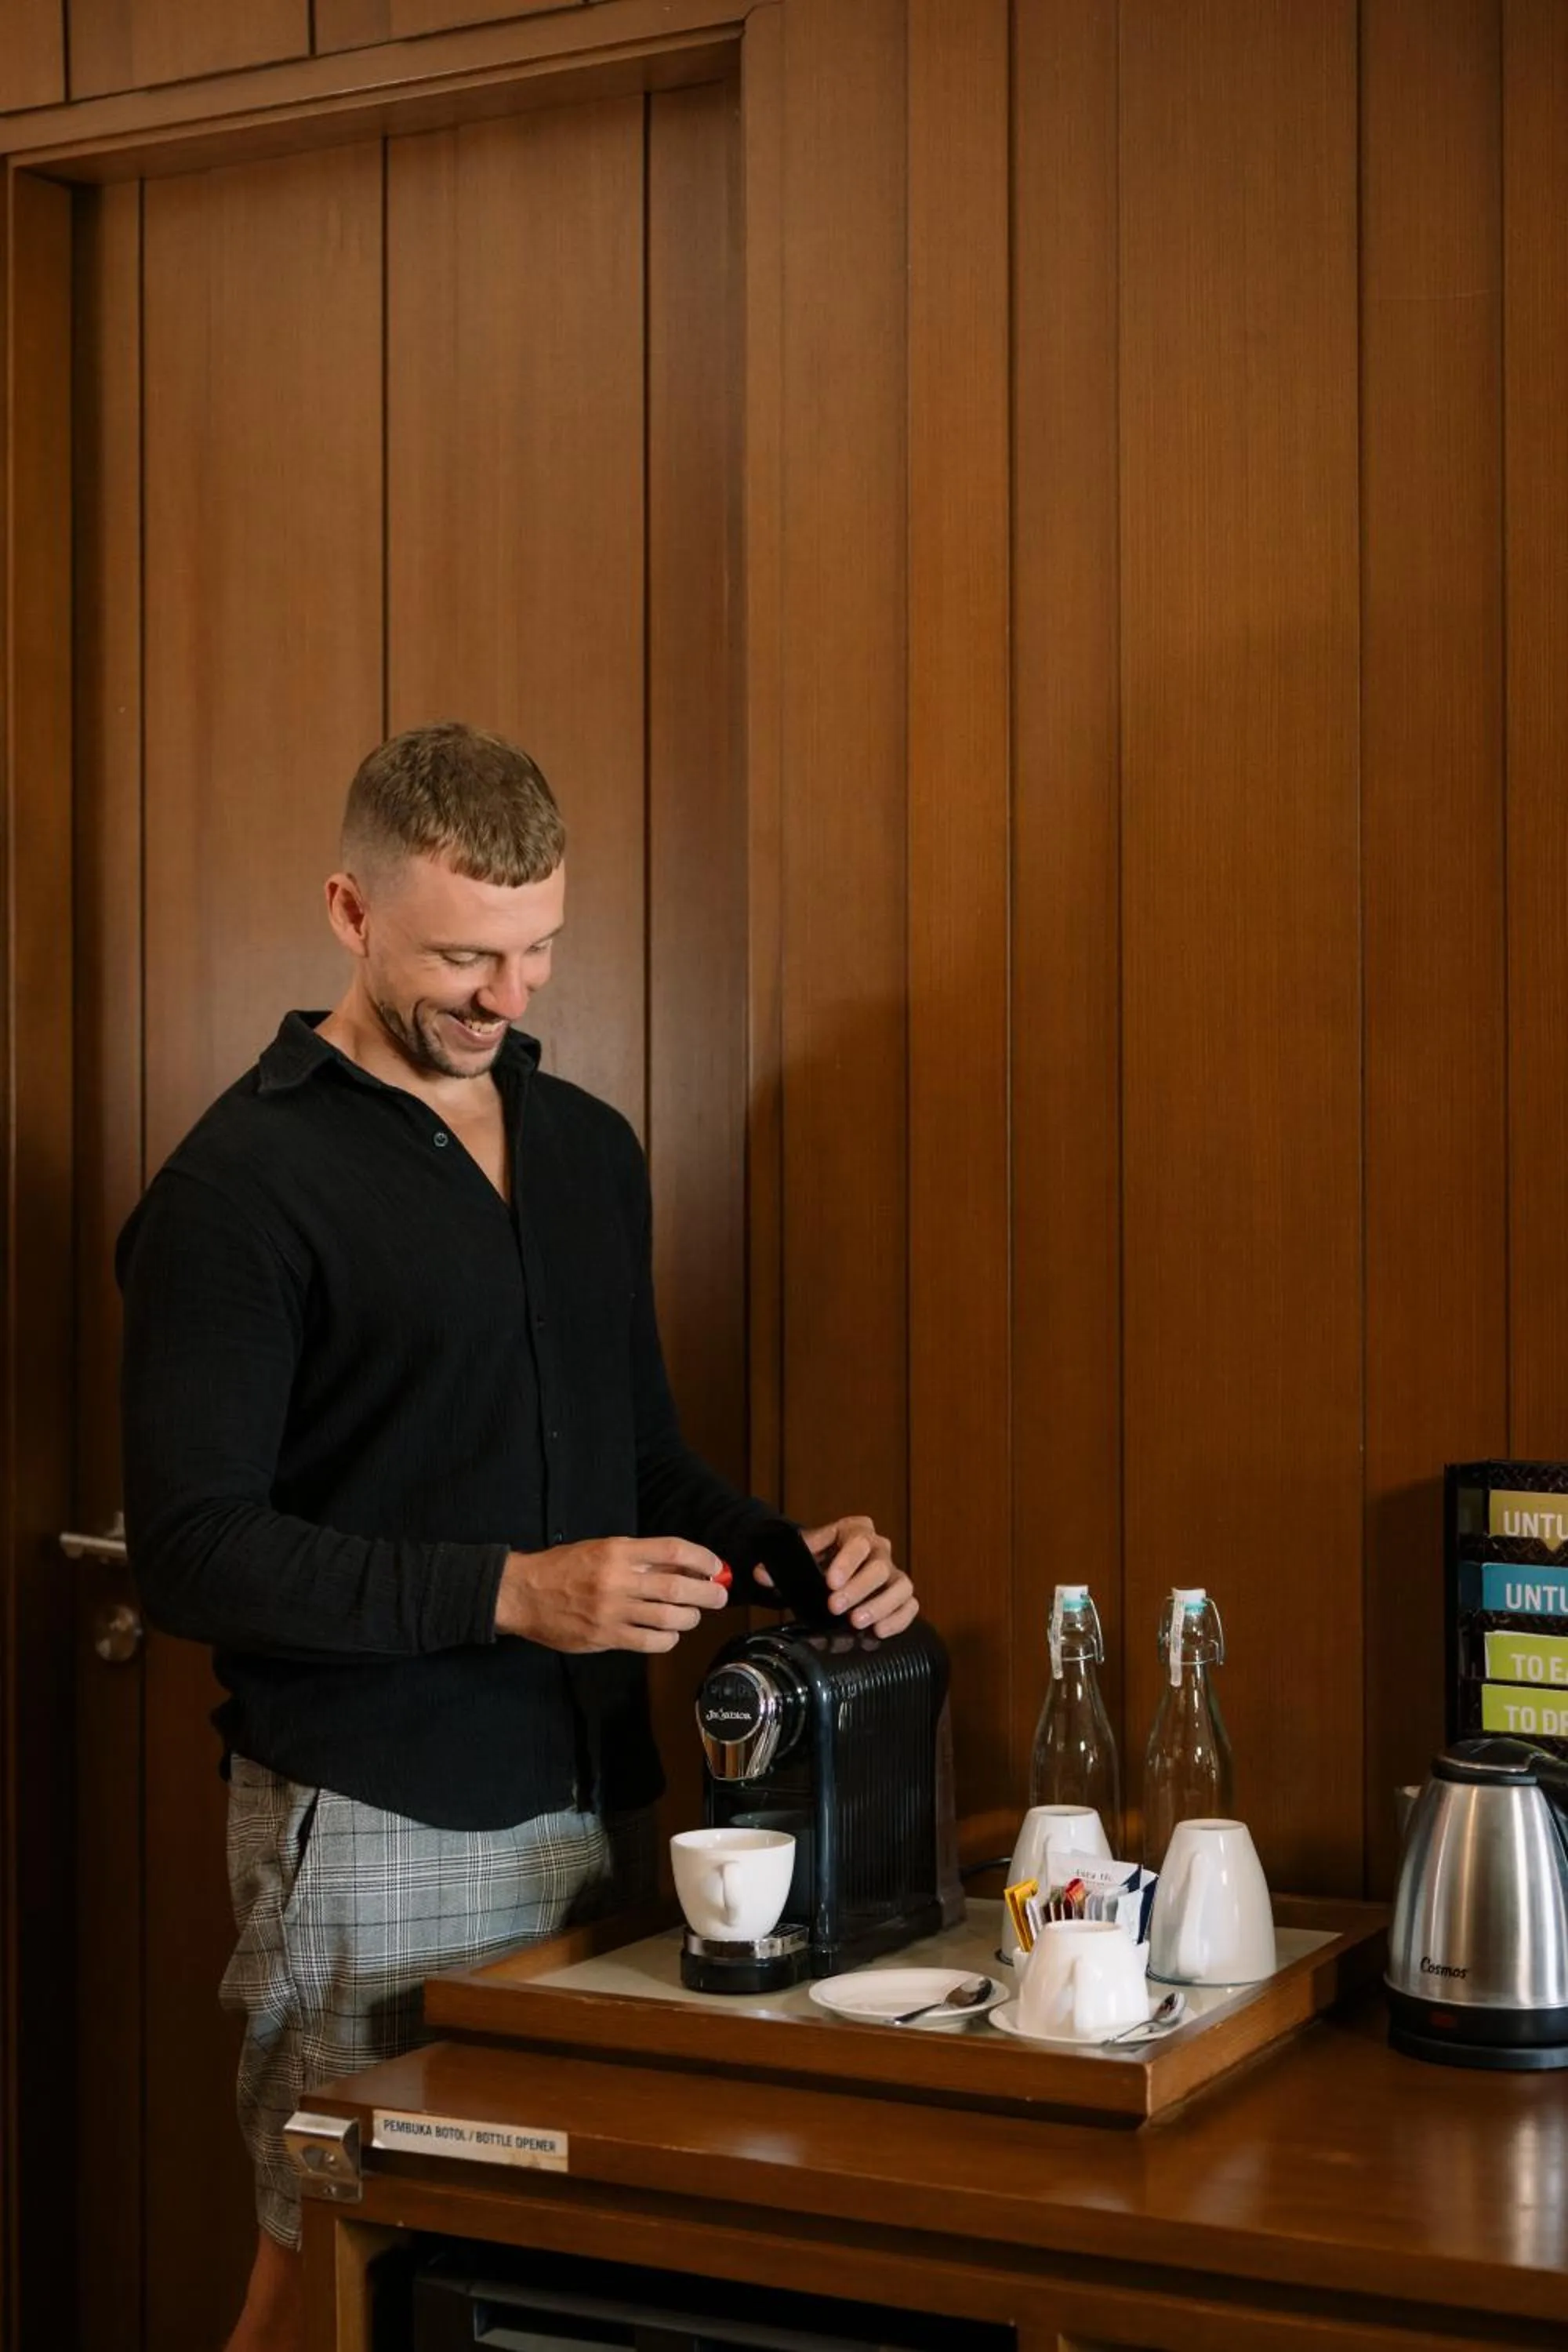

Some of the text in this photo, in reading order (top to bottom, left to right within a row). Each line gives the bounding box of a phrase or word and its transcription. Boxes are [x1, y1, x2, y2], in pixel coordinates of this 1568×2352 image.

[1509, 1652, 1544, 1683] TO
[1504, 1704, 1537, 1733] TO
[1420, 1956, 1468, 1980] Cosmos
[383, 2118, 432, 2136] PEMBUKA
[435, 2126, 466, 2142] BOTOL
[475, 2131, 513, 2147] BOTTLE
[515, 2138, 557, 2152] OPENER
